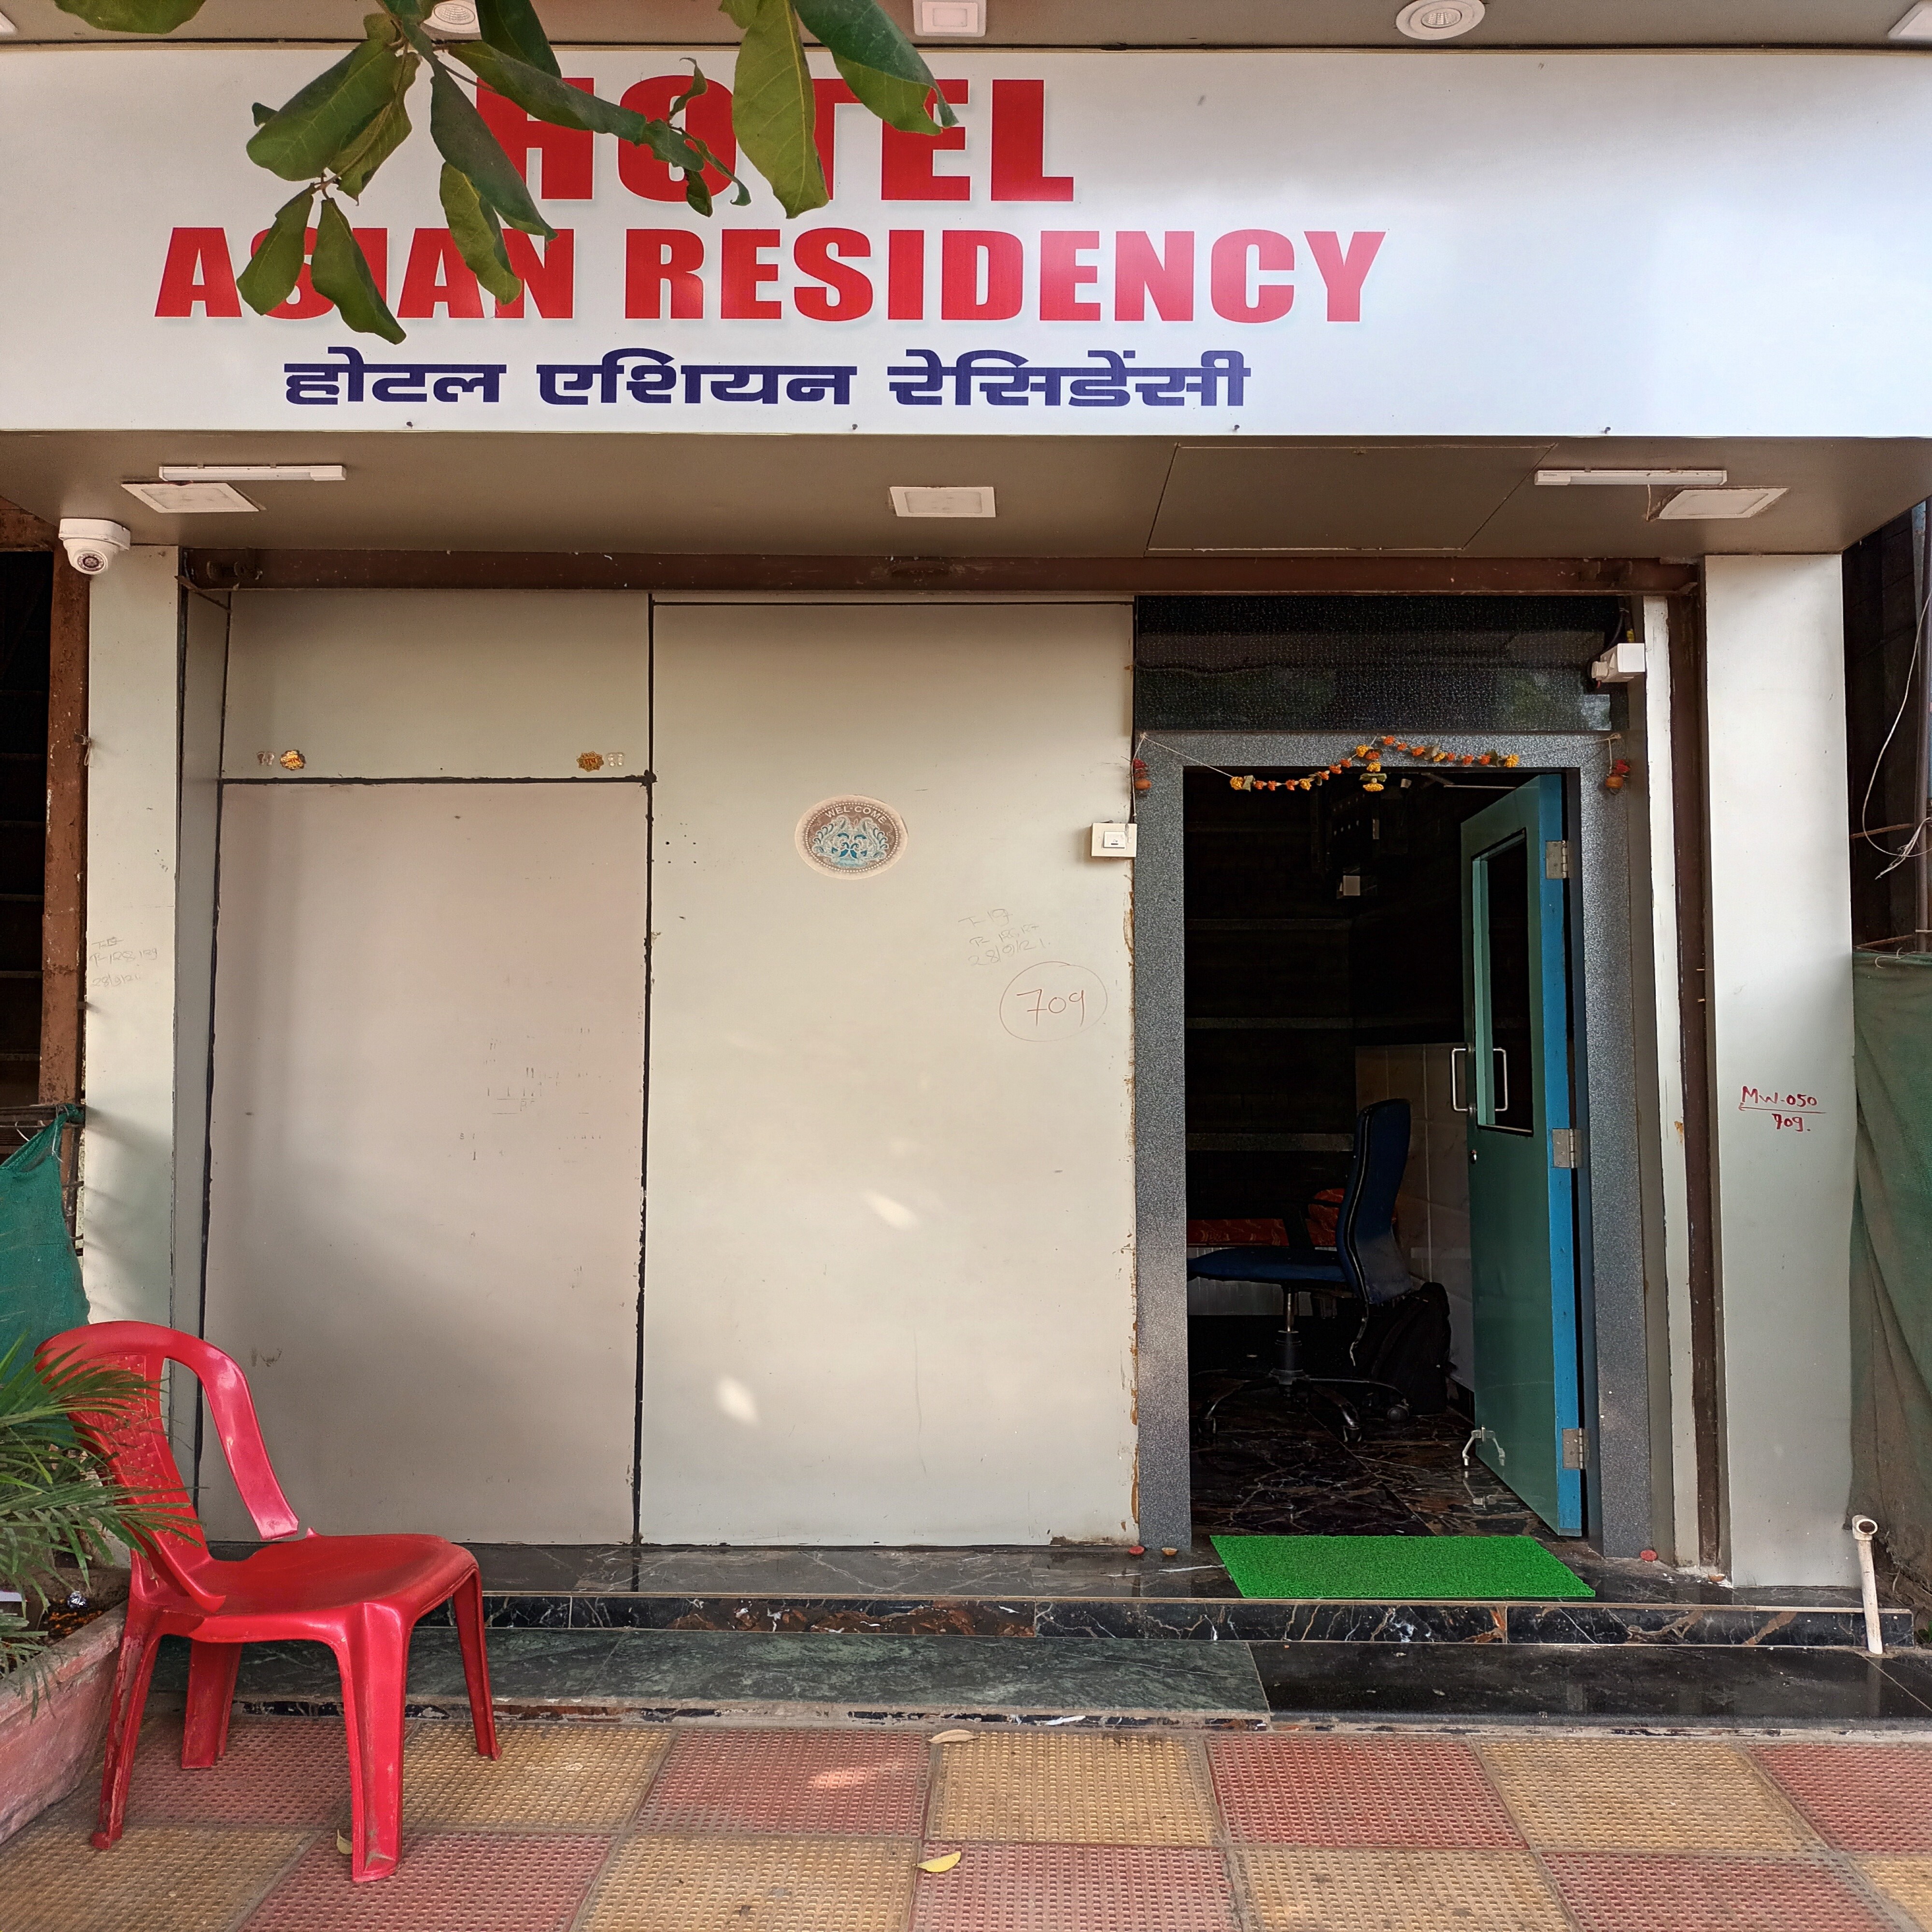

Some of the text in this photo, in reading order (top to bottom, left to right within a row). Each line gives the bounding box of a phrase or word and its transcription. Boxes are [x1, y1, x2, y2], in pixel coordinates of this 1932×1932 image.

[625, 227, 1386, 323] RESIDENCY
[284, 346, 1251, 407] होटल एशियन रेसिडेंसी
[824, 805, 887, 824] WEL-COME
[1016, 988, 1085, 1027] 709
